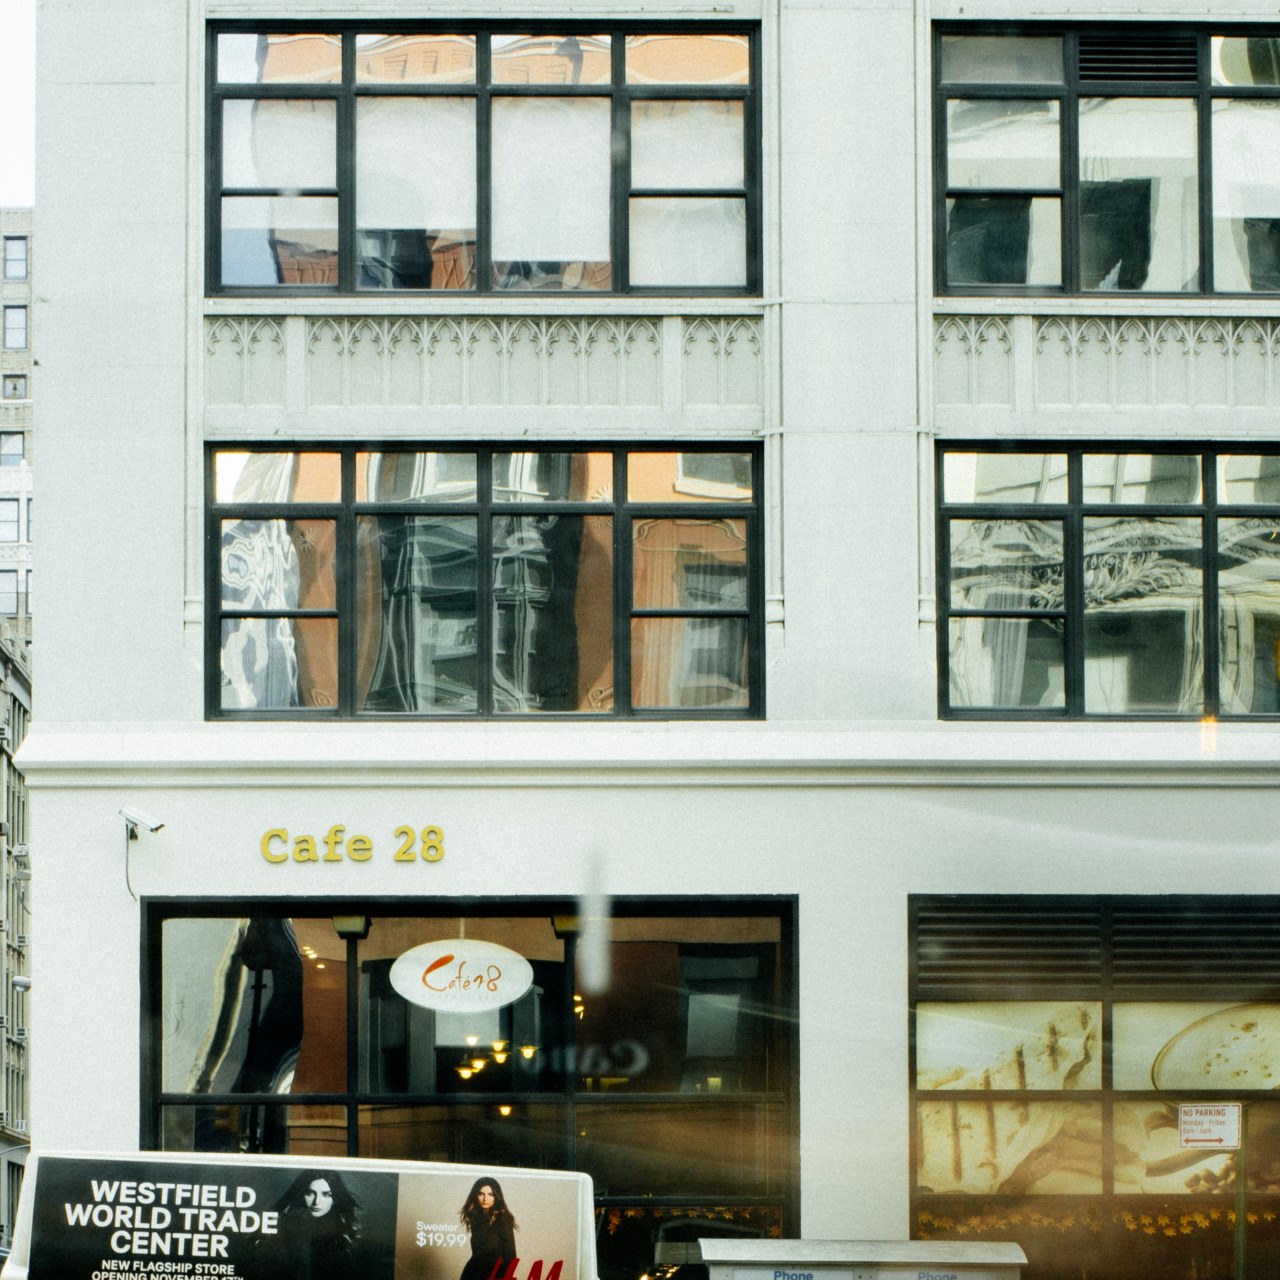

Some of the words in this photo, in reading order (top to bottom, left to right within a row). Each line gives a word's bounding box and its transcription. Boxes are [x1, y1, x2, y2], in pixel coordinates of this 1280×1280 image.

[260, 824, 373, 864] Cafe
[393, 825, 445, 864] 28
[1183, 1108, 1193, 1117] NO
[1195, 1108, 1226, 1117] PARKING
[91, 1180, 257, 1209] WESTFIELD
[64, 1203, 172, 1230] WORLD
[179, 1207, 279, 1235] TRADE
[416, 1221, 459, 1233] Sweater
[110, 1230, 229, 1258] CENTER
[416, 1231, 468, 1248] $19.99
[101, 1259, 131, 1271] NEW
[132, 1260, 193, 1274] FLAGSHIP
[194, 1263, 235, 1275] STORE
